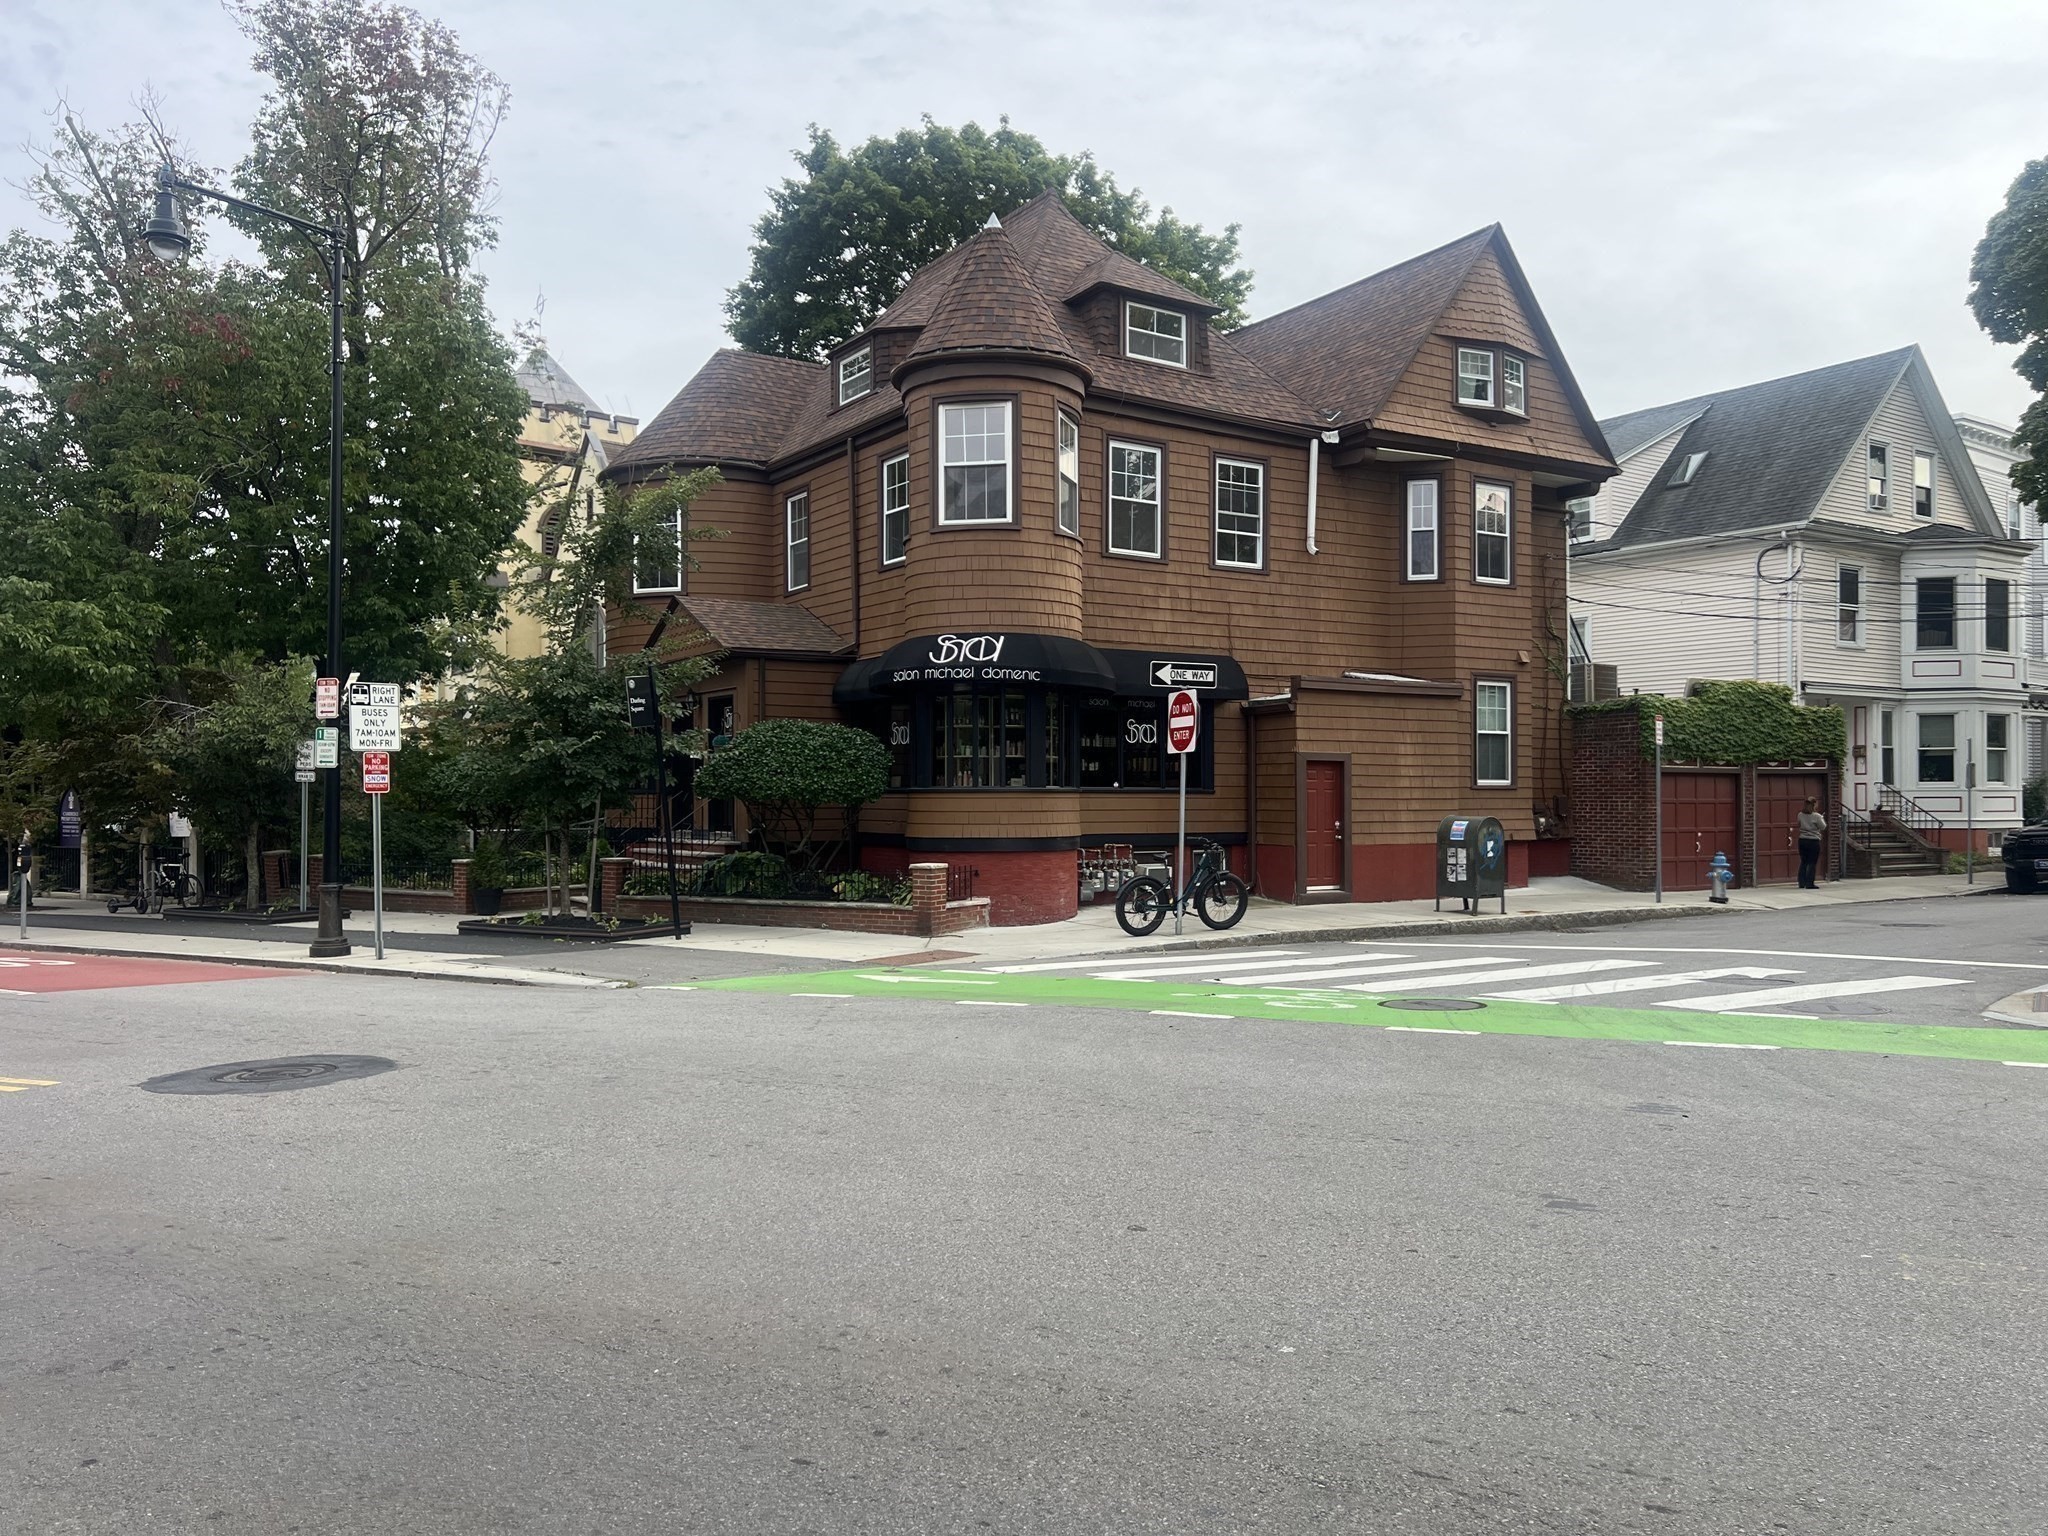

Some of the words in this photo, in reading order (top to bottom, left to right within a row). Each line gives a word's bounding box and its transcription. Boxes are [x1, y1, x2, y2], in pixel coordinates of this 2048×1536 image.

[893, 669, 920, 682] salon
[924, 666, 975, 679] michael
[981, 667, 1041, 681] domenic
[1169, 669, 1188, 680] ONE
[1191, 670, 1211, 681] WAY
[372, 687, 395, 695] RIGHT
[374, 696, 395, 704] LANE
[361, 708, 389, 717] BUSES
[1172, 704, 1181, 715] DO
[1181, 702, 1193, 713] NOT
[363, 718, 386, 727] ONLY
[318, 729, 323, 739] 1
[354, 728, 397, 737] 7AM-10AM
[1173, 730, 1190, 742] ENTER
